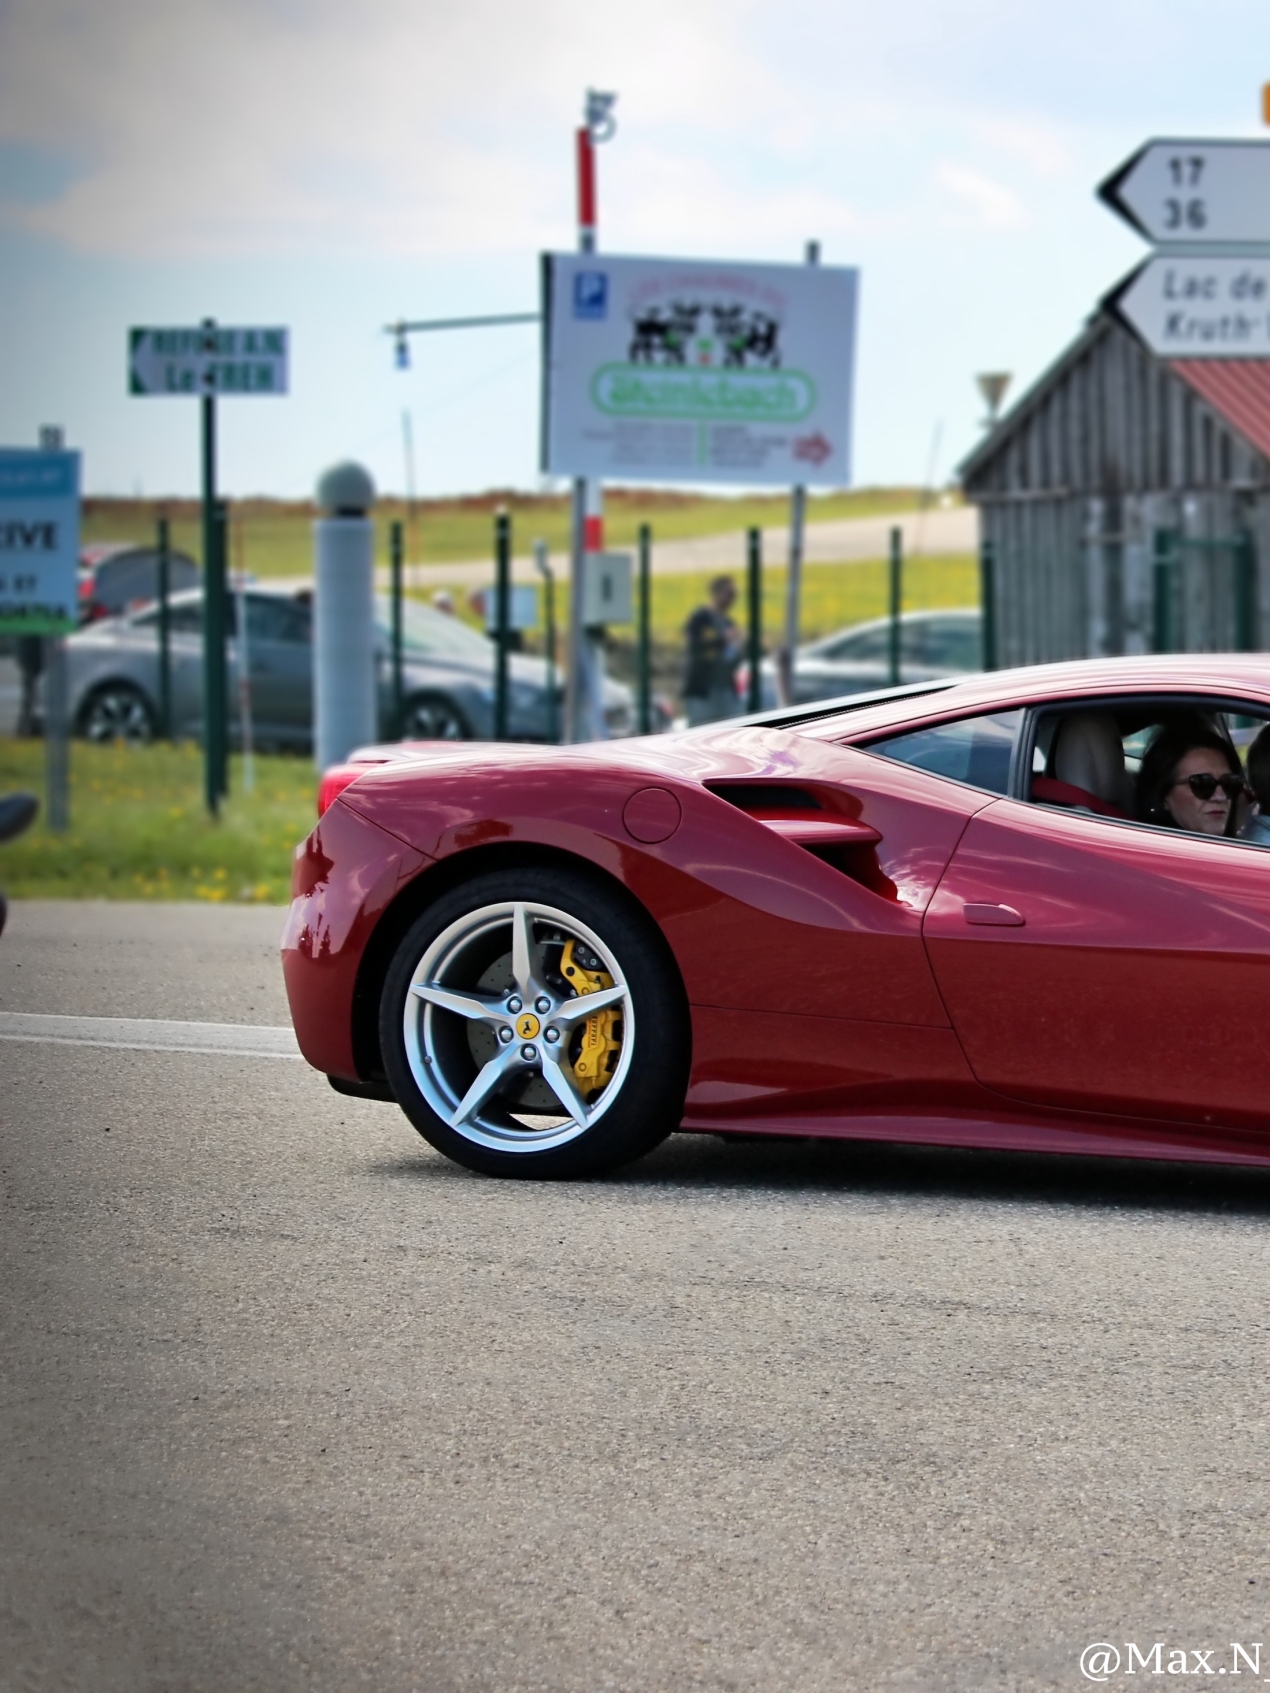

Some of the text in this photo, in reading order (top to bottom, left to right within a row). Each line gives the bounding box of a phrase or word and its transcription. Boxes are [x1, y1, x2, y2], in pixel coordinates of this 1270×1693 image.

[1166, 156, 1206, 188] 17
[1163, 198, 1208, 231] 36
[1163, 268, 1268, 301] Lac de
[0, 519, 59, 552] IVE
